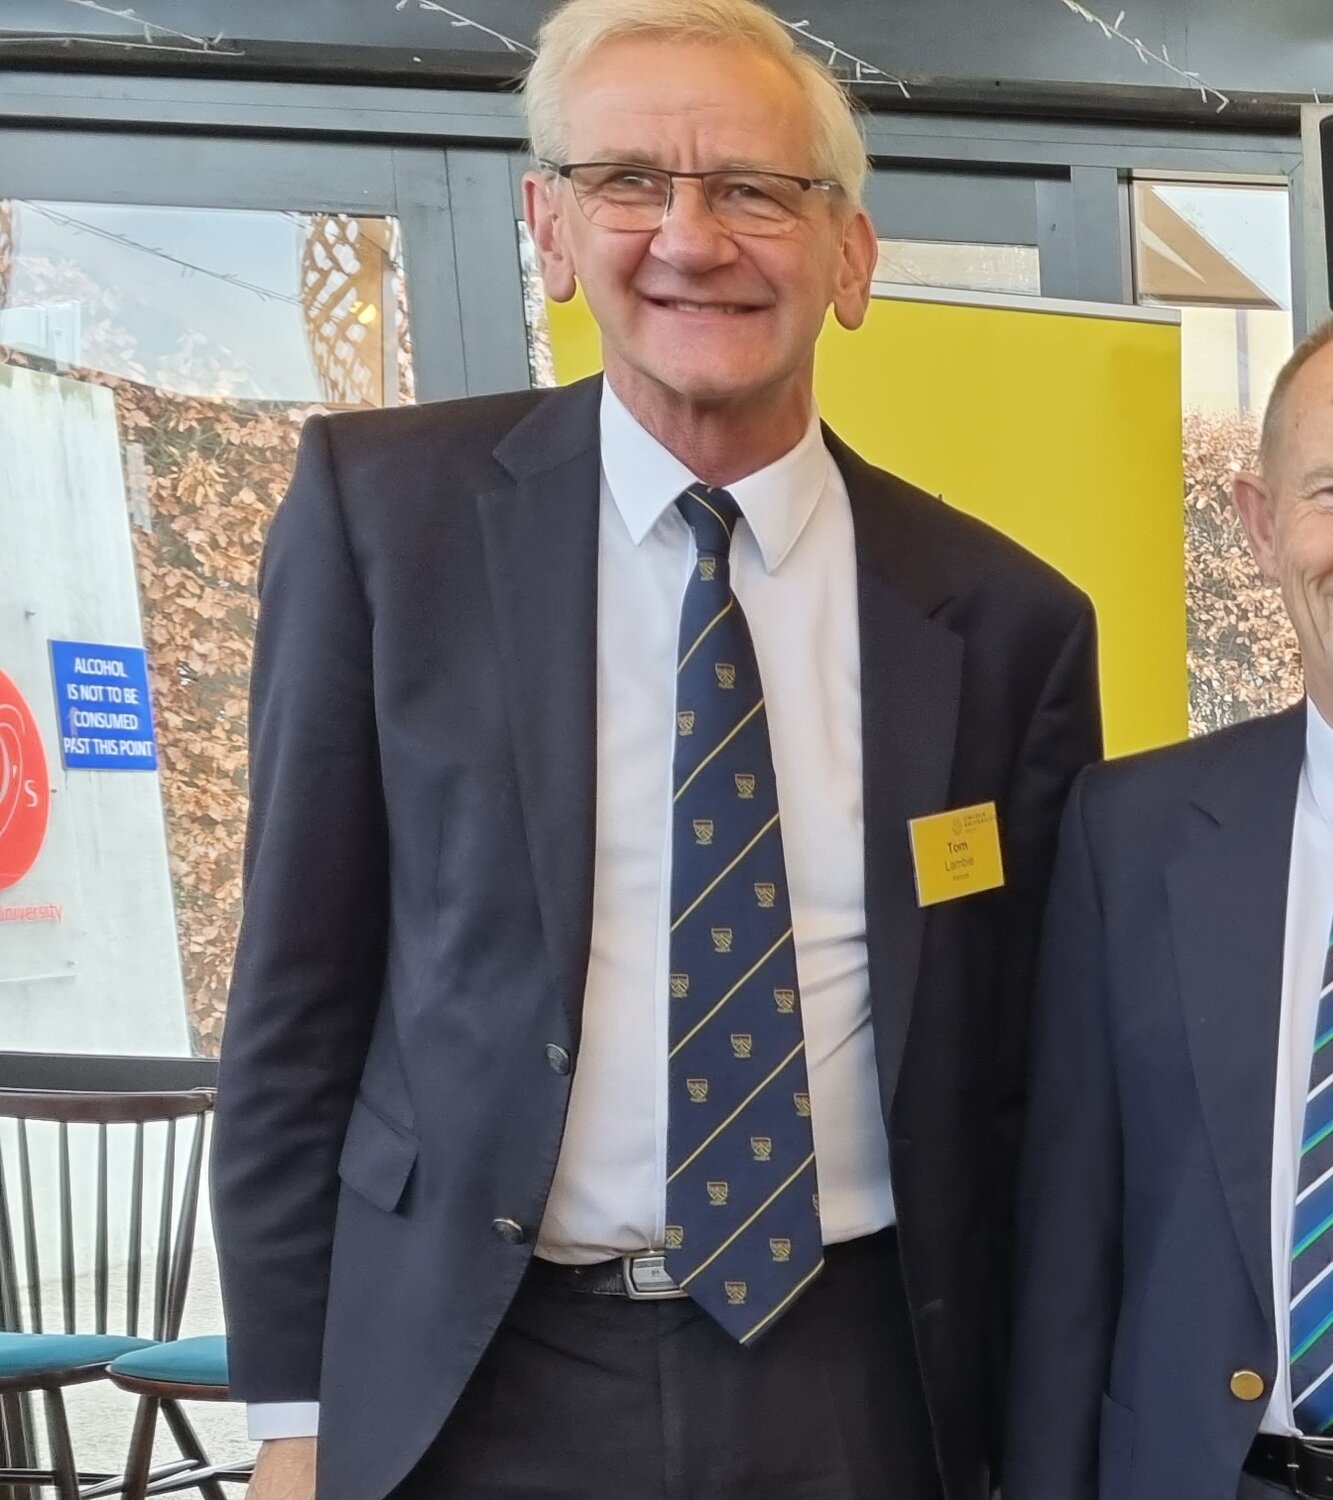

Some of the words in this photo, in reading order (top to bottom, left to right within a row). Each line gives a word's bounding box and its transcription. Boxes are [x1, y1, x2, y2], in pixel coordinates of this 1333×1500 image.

[74, 657, 126, 678] ALCOHOL
[67, 684, 78, 700] IS
[80, 685, 104, 701] NOT
[106, 687, 121, 702] TO
[124, 688, 138, 703] BE
[73, 712, 138, 730] CONSUMED
[64, 737, 91, 755] PAST
[93, 739, 118, 756] THIS
[119, 740, 154, 757] POINT
[946, 841, 969, 854] Tom
